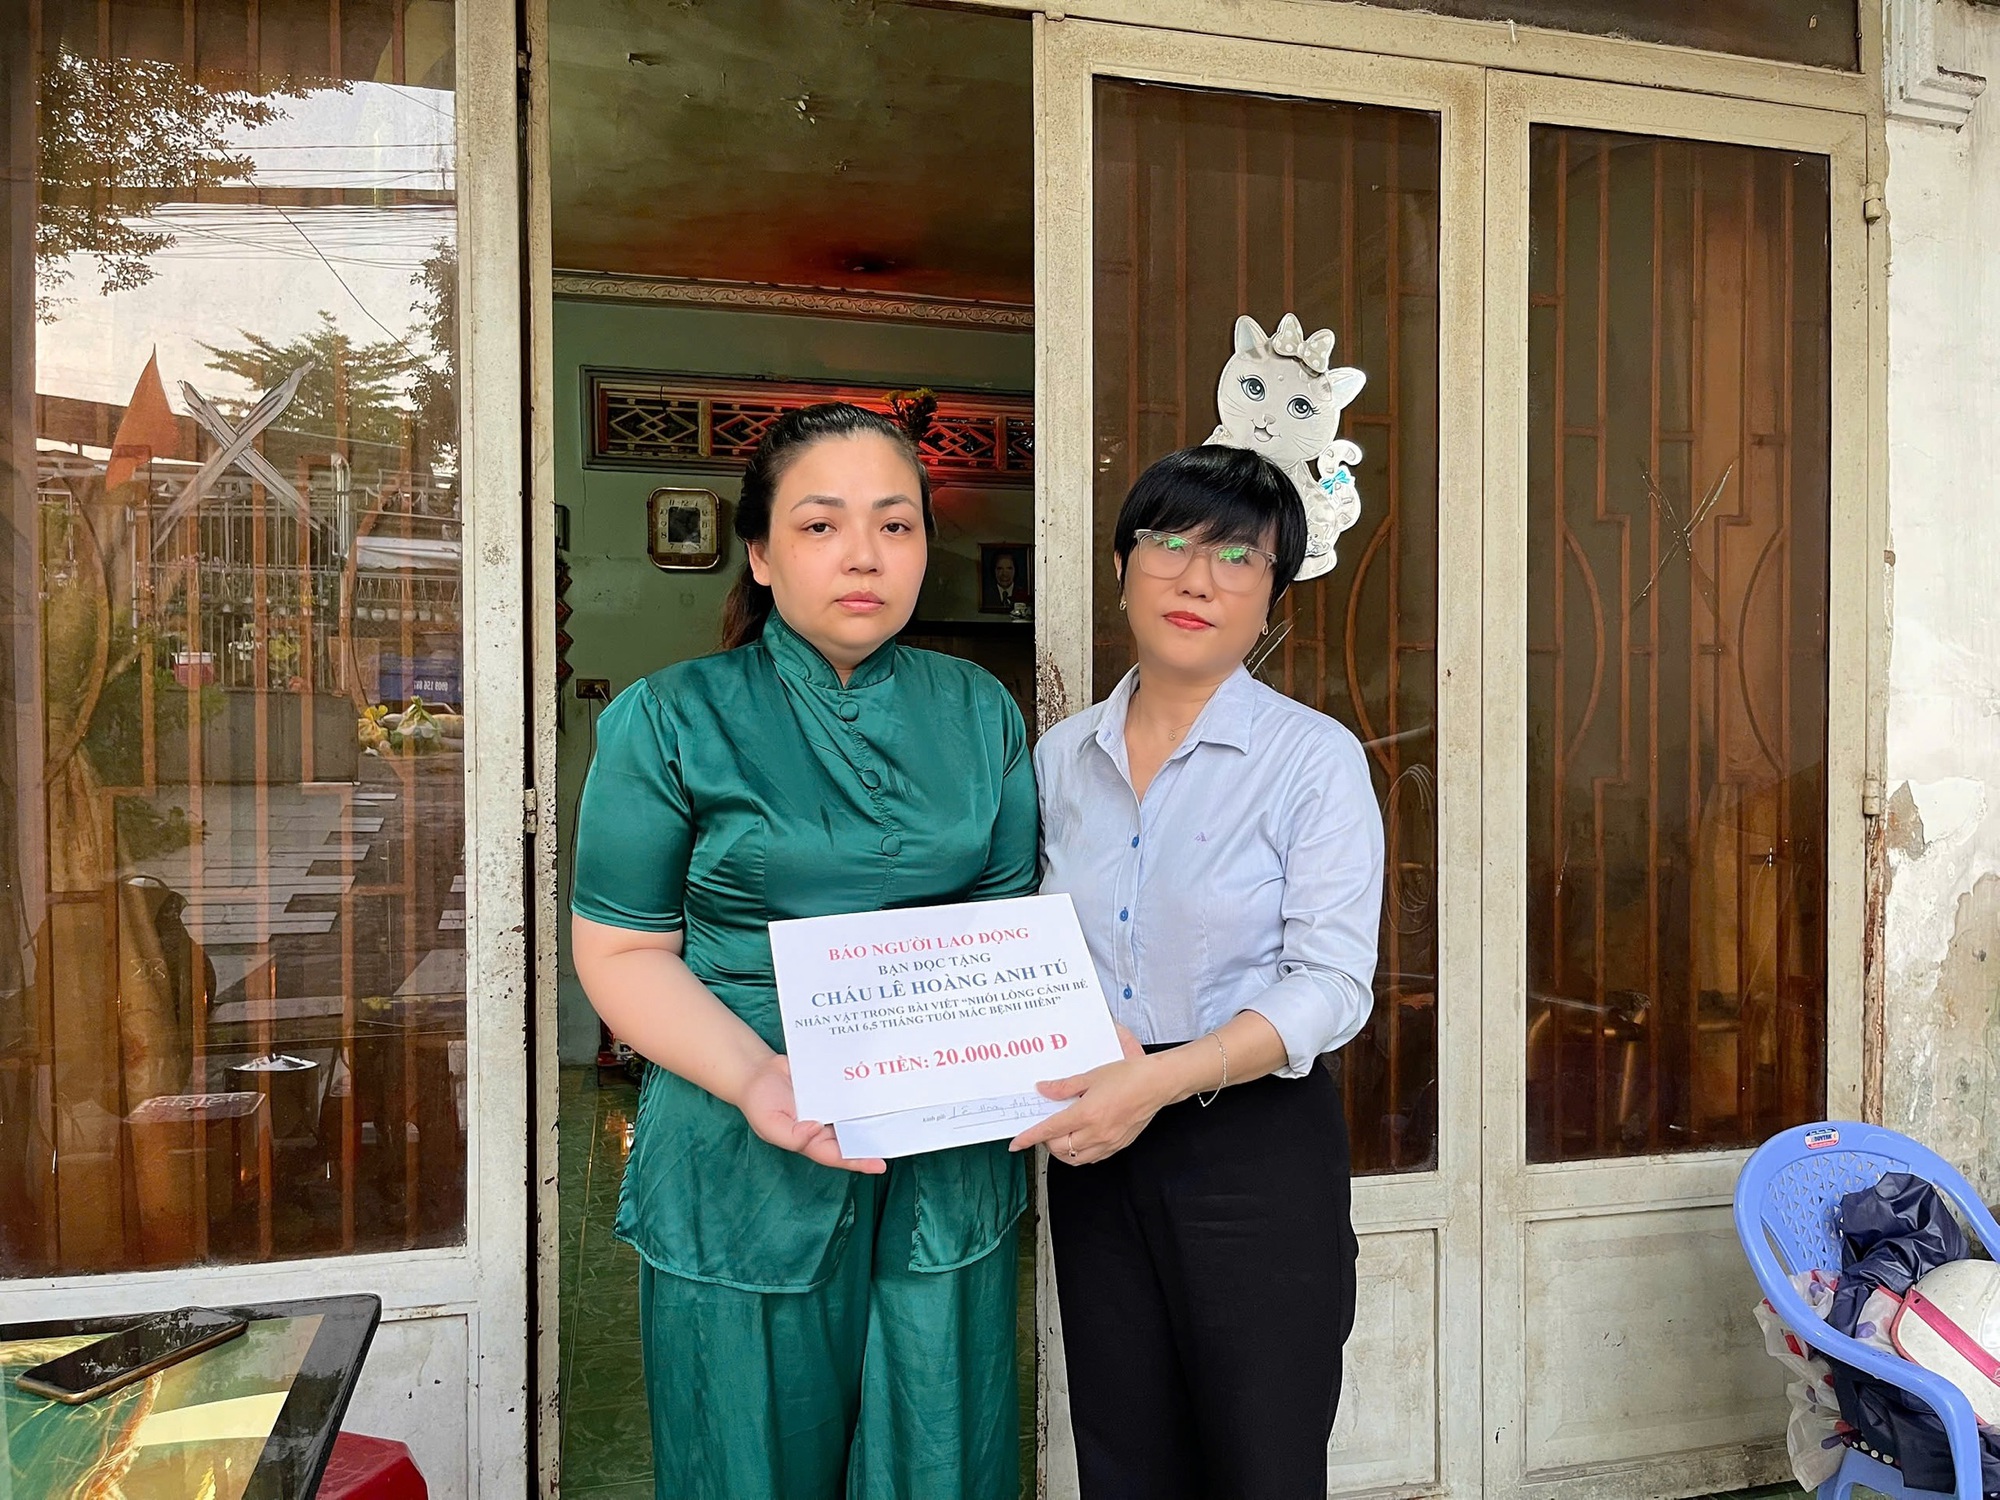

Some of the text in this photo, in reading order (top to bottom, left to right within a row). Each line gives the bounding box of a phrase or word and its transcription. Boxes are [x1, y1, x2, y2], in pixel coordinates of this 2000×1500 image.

[829, 928, 1029, 961] BÁO NGƯỜI LAO ĐỘNG
[878, 953, 991, 976] BẠN ĐỌC TẶNG
[795, 1015, 831, 1028] NHÂN
[833, 1011, 859, 1024] VẬT
[860, 1006, 905, 1018] TRONG
[908, 1002, 929, 1013] BÀI
[930, 998, 960, 1010] VIẾT
[1001, 989, 1034, 1001] LÒNG
[1072, 978, 1088, 990] BÉ
[811, 959, 1069, 1008] CHÁU LÊ HOÀNG ANH TÚ
[829, 1025, 860, 1036] TRAI
[862, 1021, 878, 1031] 6,5
[879, 1015, 924, 1028] THÁNG
[989, 1003, 1022, 1015] BỆNH
[843, 1033, 1068, 1081] SỐ TIỀN: 20.000.000 Đ
